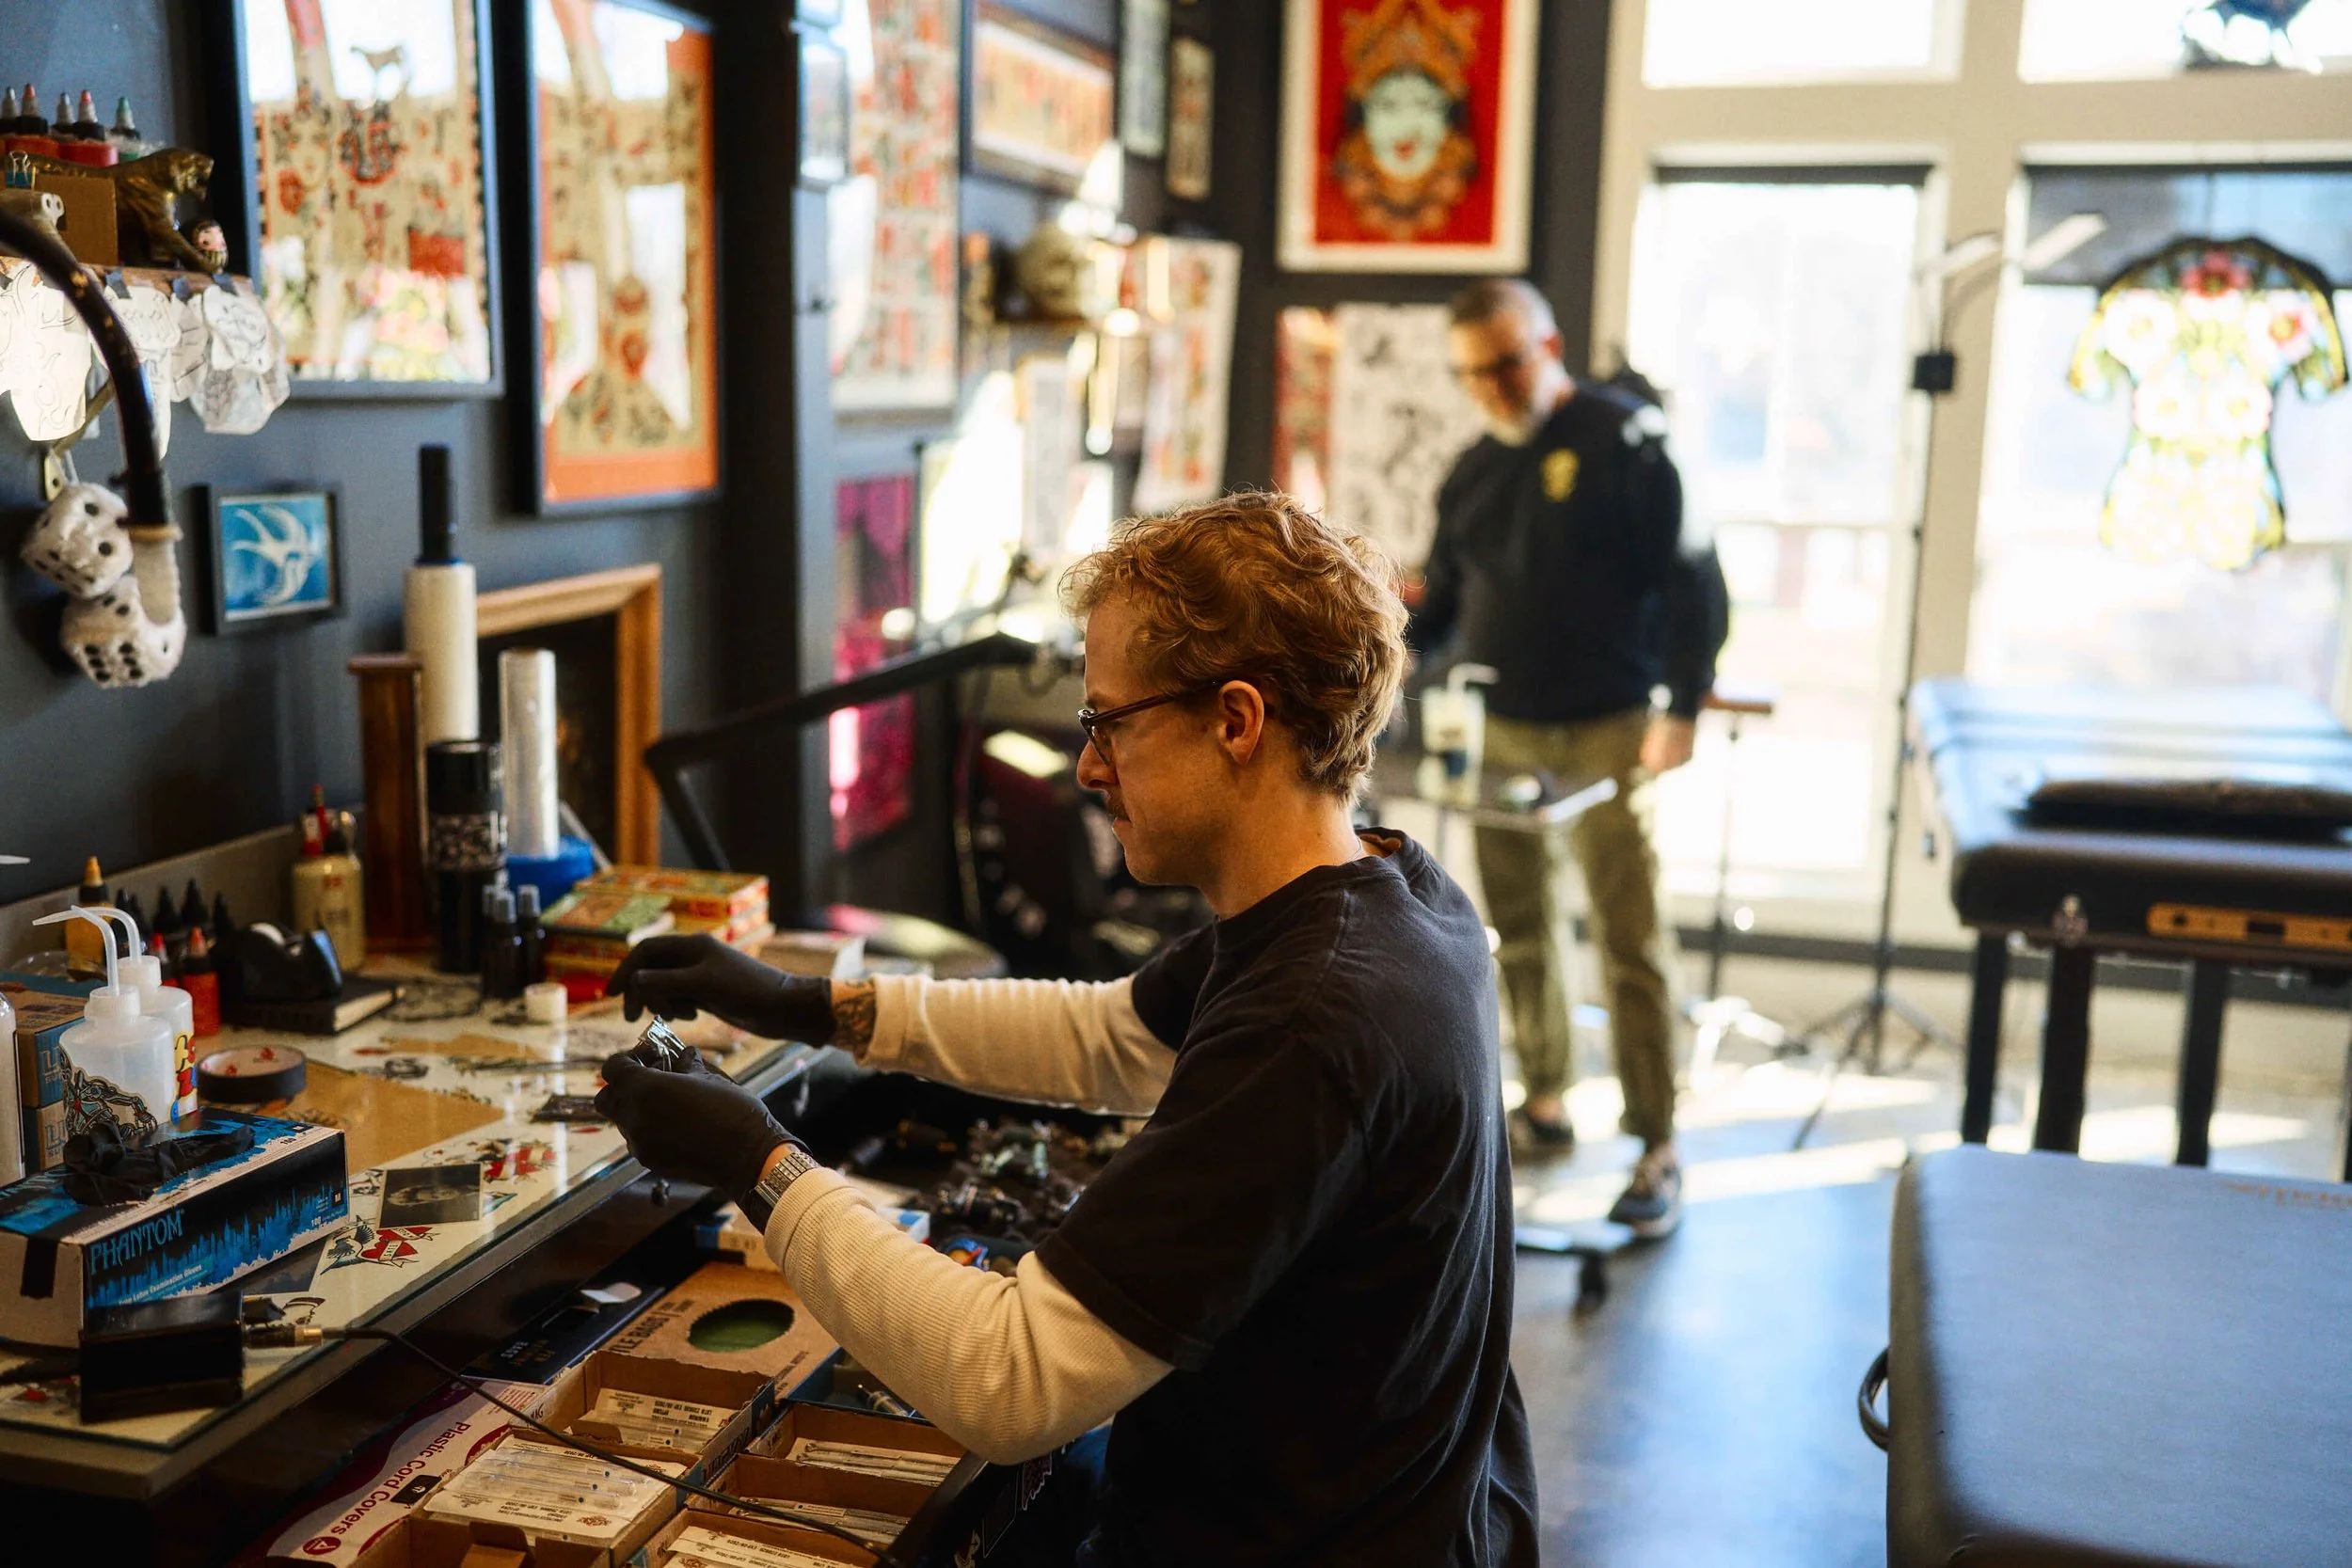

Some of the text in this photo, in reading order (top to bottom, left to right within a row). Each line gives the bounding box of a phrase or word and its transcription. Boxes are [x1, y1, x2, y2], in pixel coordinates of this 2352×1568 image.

[90, 1212, 183, 1275] PHANTOM
[330, 1420, 471, 1536] Plastic Cord Covers
